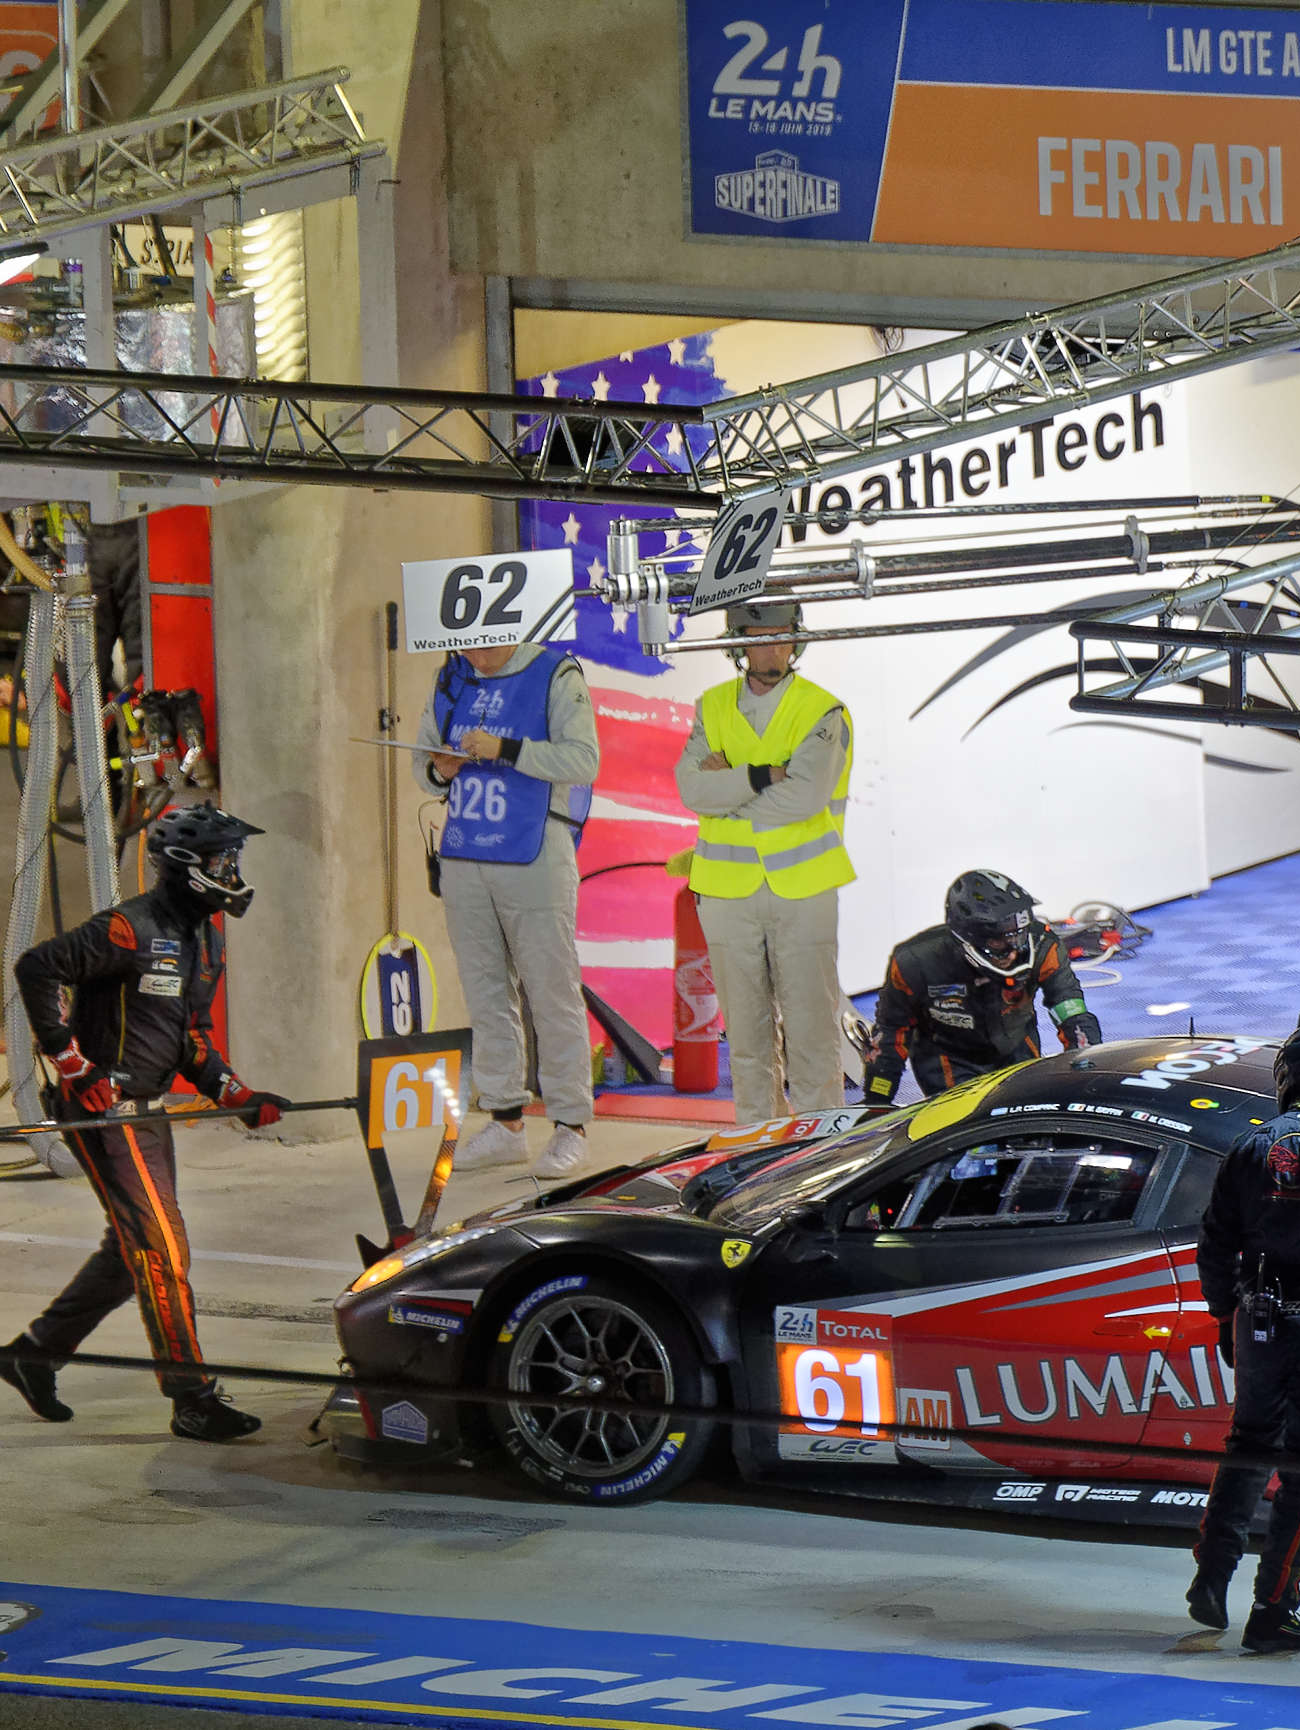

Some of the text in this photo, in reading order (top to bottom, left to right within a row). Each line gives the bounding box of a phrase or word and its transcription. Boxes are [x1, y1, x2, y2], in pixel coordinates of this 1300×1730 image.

[712, 20, 842, 98] 24h
[1166, 27, 1212, 75] LM
[1219, 29, 1273, 77] GTE
[708, 97, 834, 123] LE MANS
[717, 169, 838, 220] SUPERFINALE
[1037, 136, 1284, 226] FERRARI
[715, 507, 778, 580] 62
[440, 561, 528, 630] 62
[695, 579, 762, 607] WeatherTech
[414, 632, 517, 650] WeatherTech
[383, 1058, 448, 1132] 61
[515, 1276, 583, 1317] MICHELIN
[779, 1312, 813, 1332] 24h
[820, 1320, 888, 1341] TOTAL
[795, 1349, 881, 1436] 61
[905, 1397, 949, 1442] AM
[809, 1439, 879, 1456] WEC
[600, 1455, 668, 1496] MICHELIN
[996, 1485, 1043, 1498] OMP
